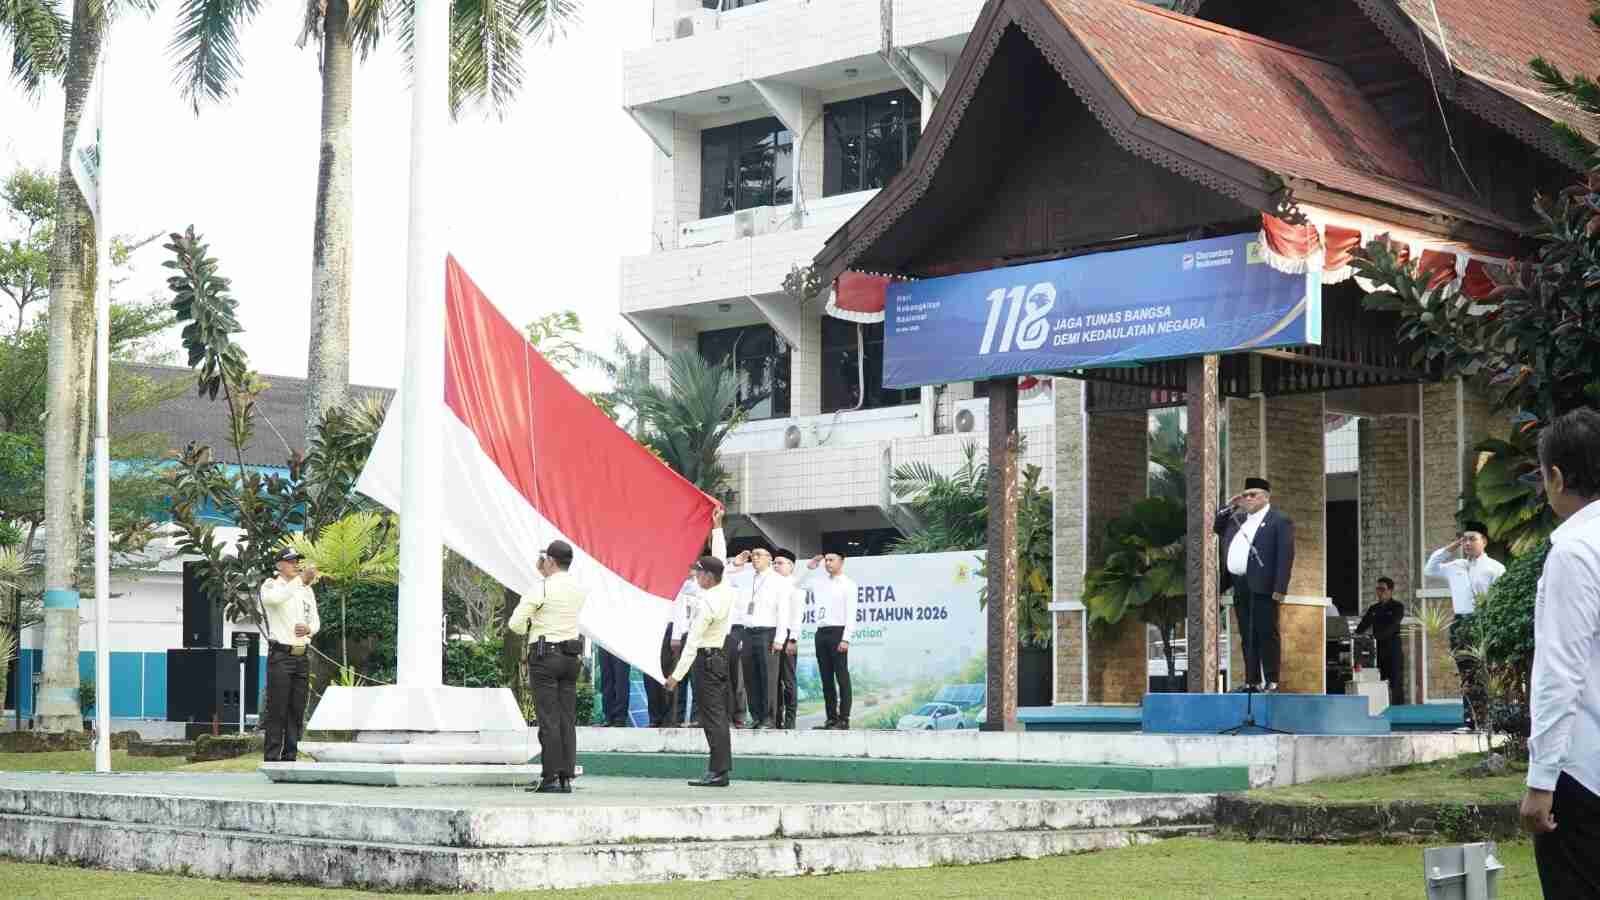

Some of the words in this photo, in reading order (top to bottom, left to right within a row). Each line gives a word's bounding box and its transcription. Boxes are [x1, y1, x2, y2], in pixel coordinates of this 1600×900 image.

[979, 282, 1057, 355] 118
[1052, 331, 1081, 347] DEMI
[1082, 322, 1155, 343] KEDAULATAN
[1156, 315, 1206, 334] NEGARA
[1053, 315, 1083, 331] JAGA
[1085, 310, 1122, 327] TUNAS
[1123, 304, 1172, 322] BANGSA
[856, 584, 896, 604] ERTA
[869, 606, 914, 622] TAHUN
[915, 605, 949, 621] 2026
